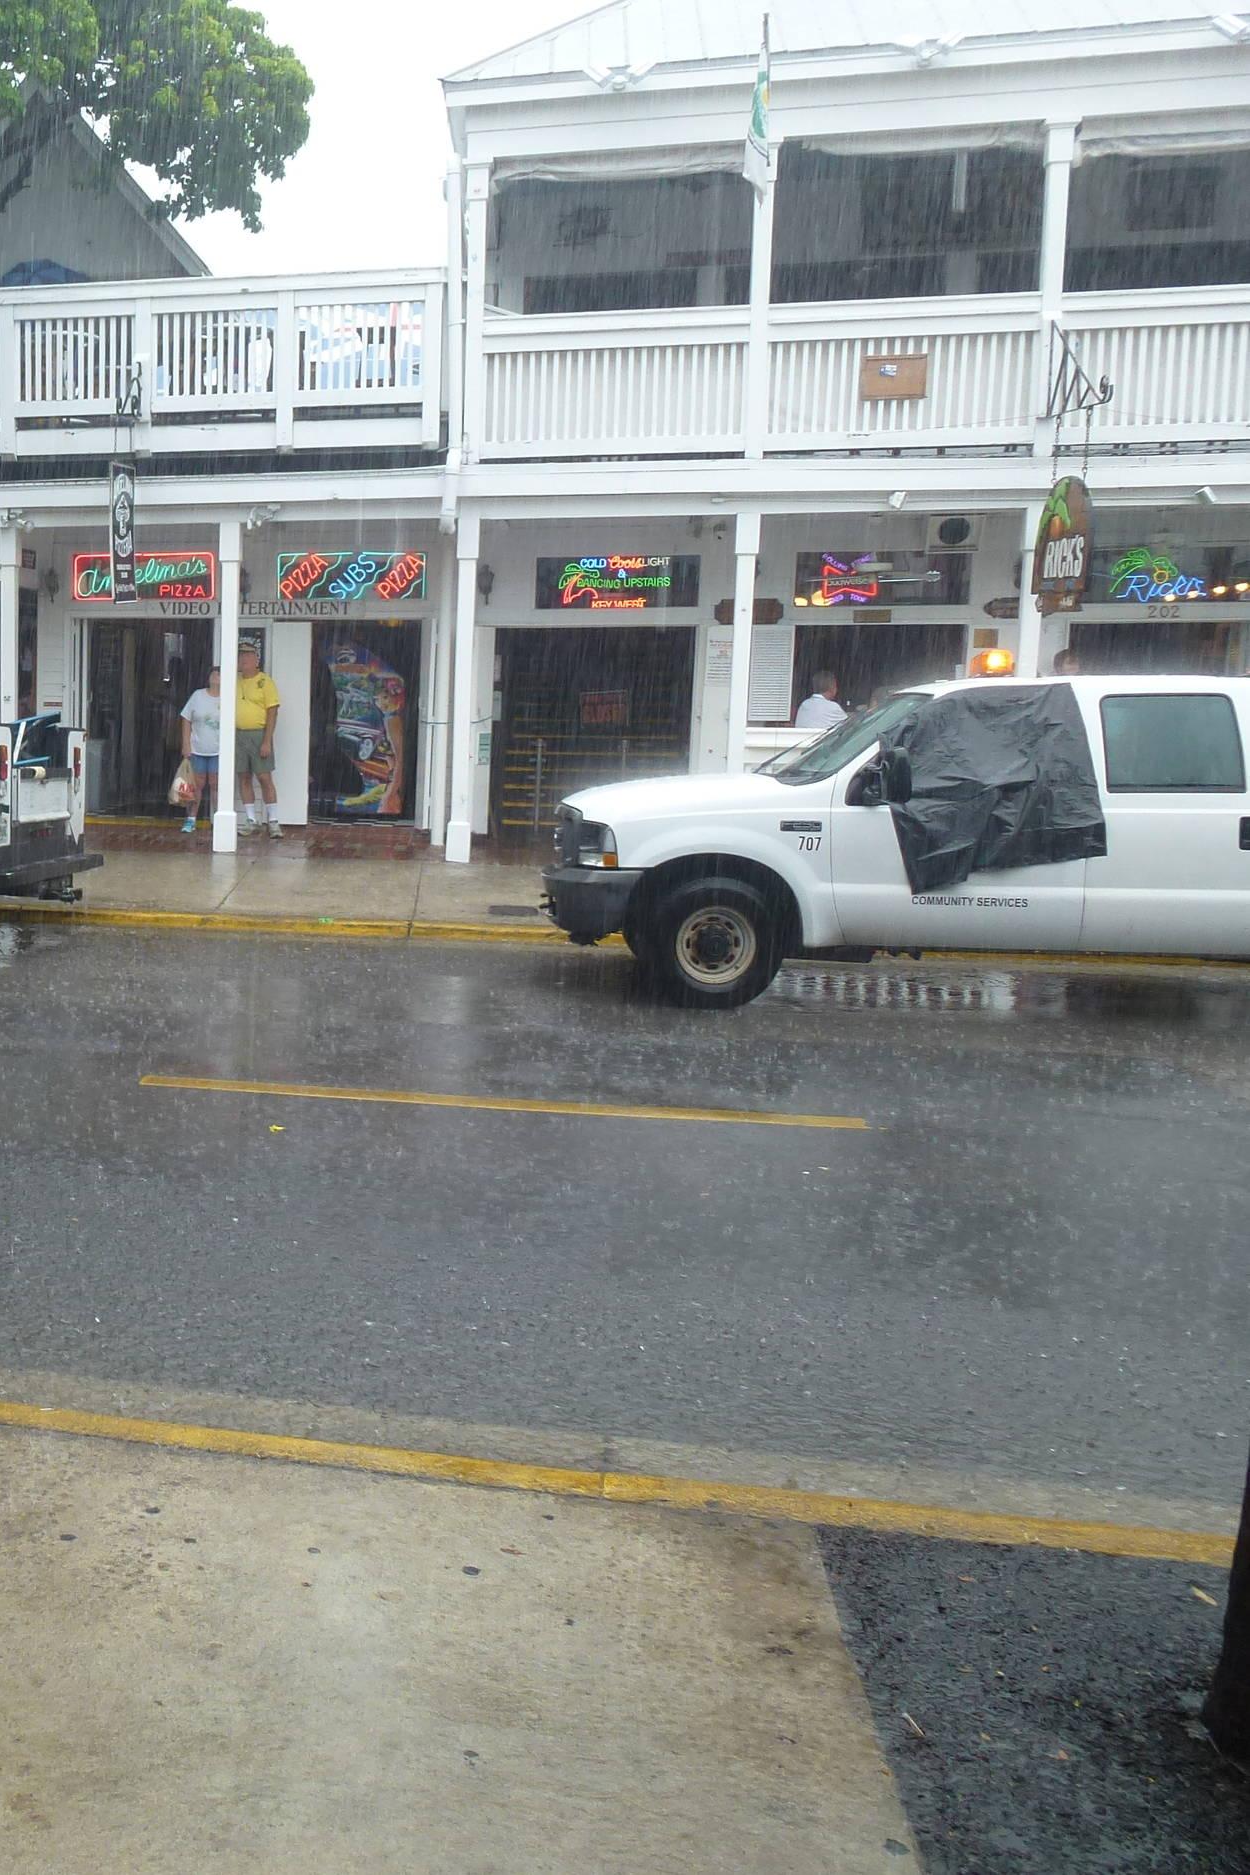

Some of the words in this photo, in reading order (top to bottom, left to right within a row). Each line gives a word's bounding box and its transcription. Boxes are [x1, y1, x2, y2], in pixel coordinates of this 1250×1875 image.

[580, 558, 607, 569] COLD
[642, 556, 670, 567] LIGHT
[1043, 534, 1084, 578] RICK'S
[280, 553, 328, 599] PIZZA
[328, 553, 376, 600] SUBS
[377, 553, 425, 599] PIZZA
[623, 576, 671, 588] UPSTAIRS
[159, 584, 206, 597] PIZZA
[160, 601, 210, 616] VIDEO
[218, 600, 350, 616] TERTAINMENT
[1147, 604, 1180, 618] 202
[798, 836, 822, 851] 707
[911, 895, 974, 907] COMMUNITY
[976, 897, 1029, 909] SERVICES
